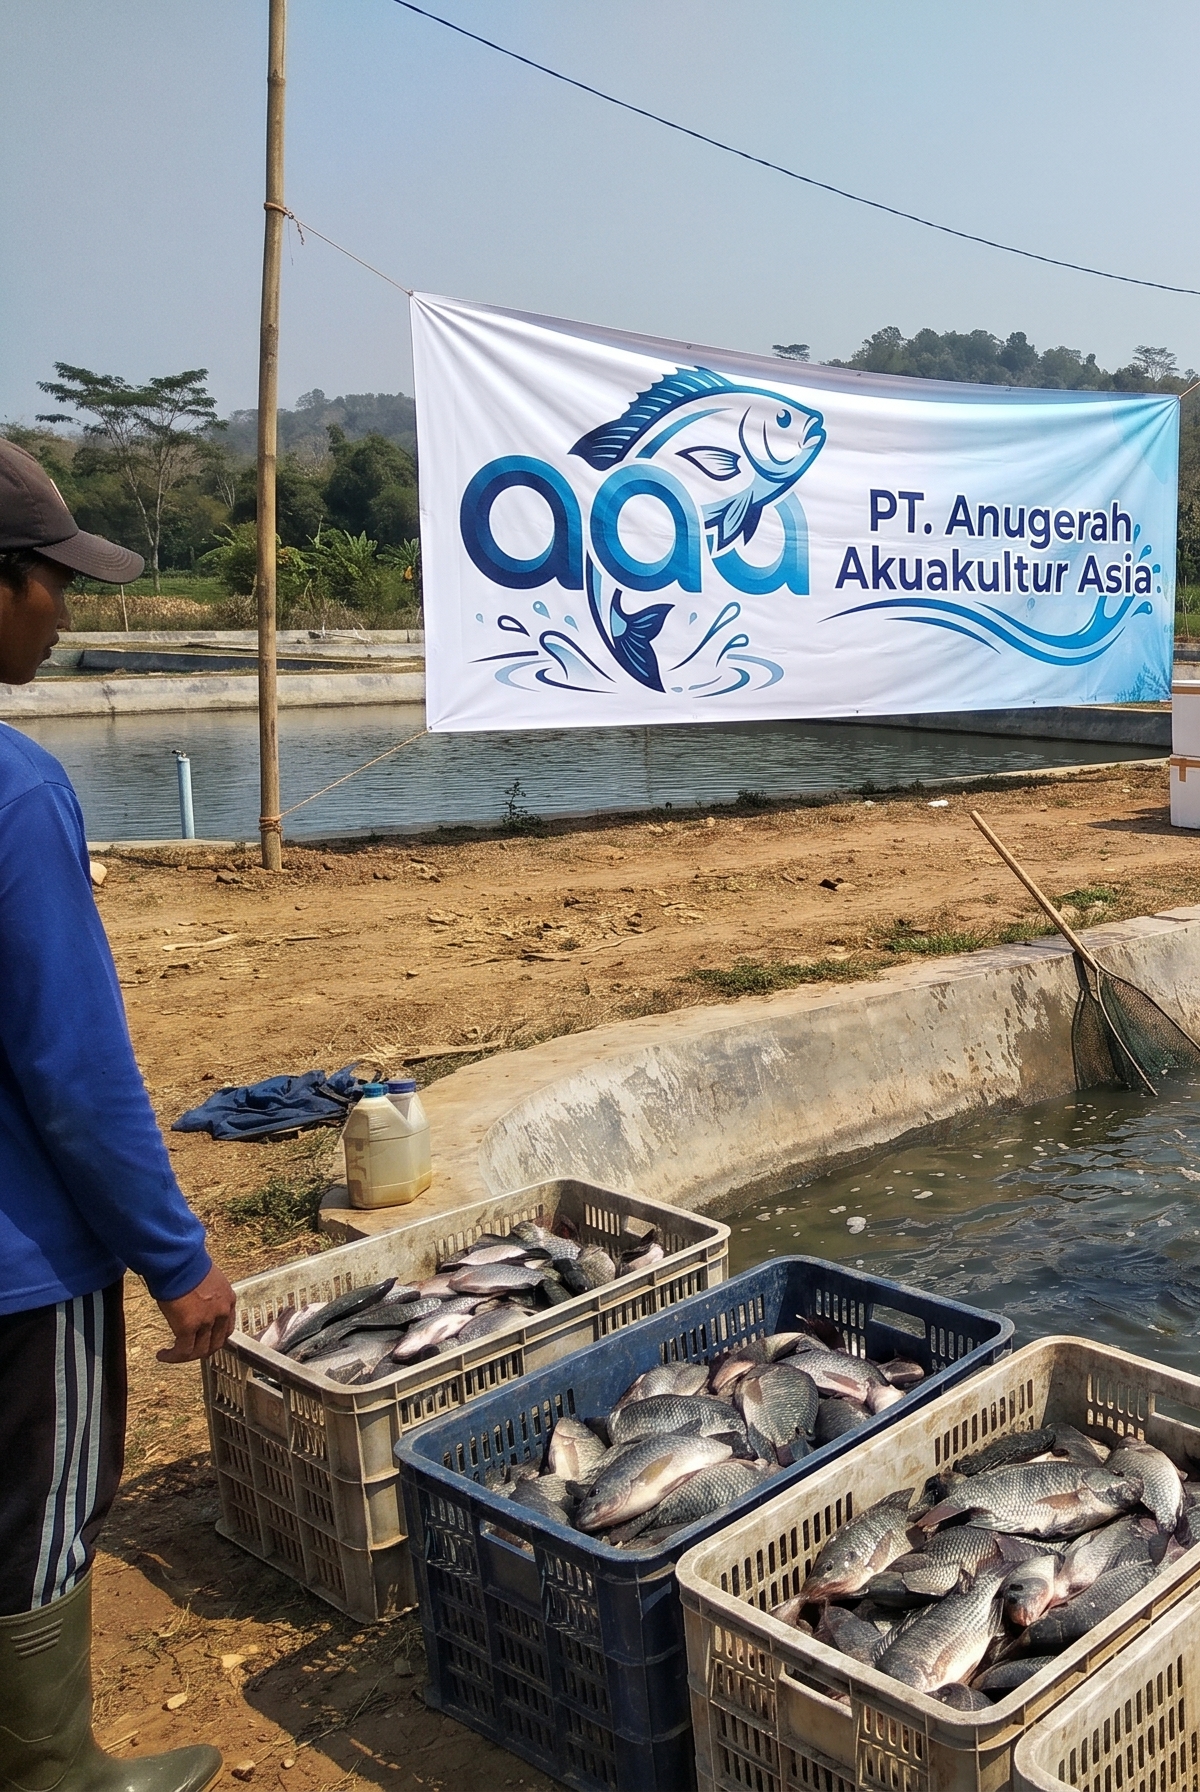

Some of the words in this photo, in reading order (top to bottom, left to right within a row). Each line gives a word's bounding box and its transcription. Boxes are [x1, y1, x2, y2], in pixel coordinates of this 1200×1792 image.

[869, 488, 932, 535] PT.
[945, 494, 1132, 550] Anugerah
[835, 545, 1069, 594] Akuakultur
[1077, 553, 1152, 594] Asia
